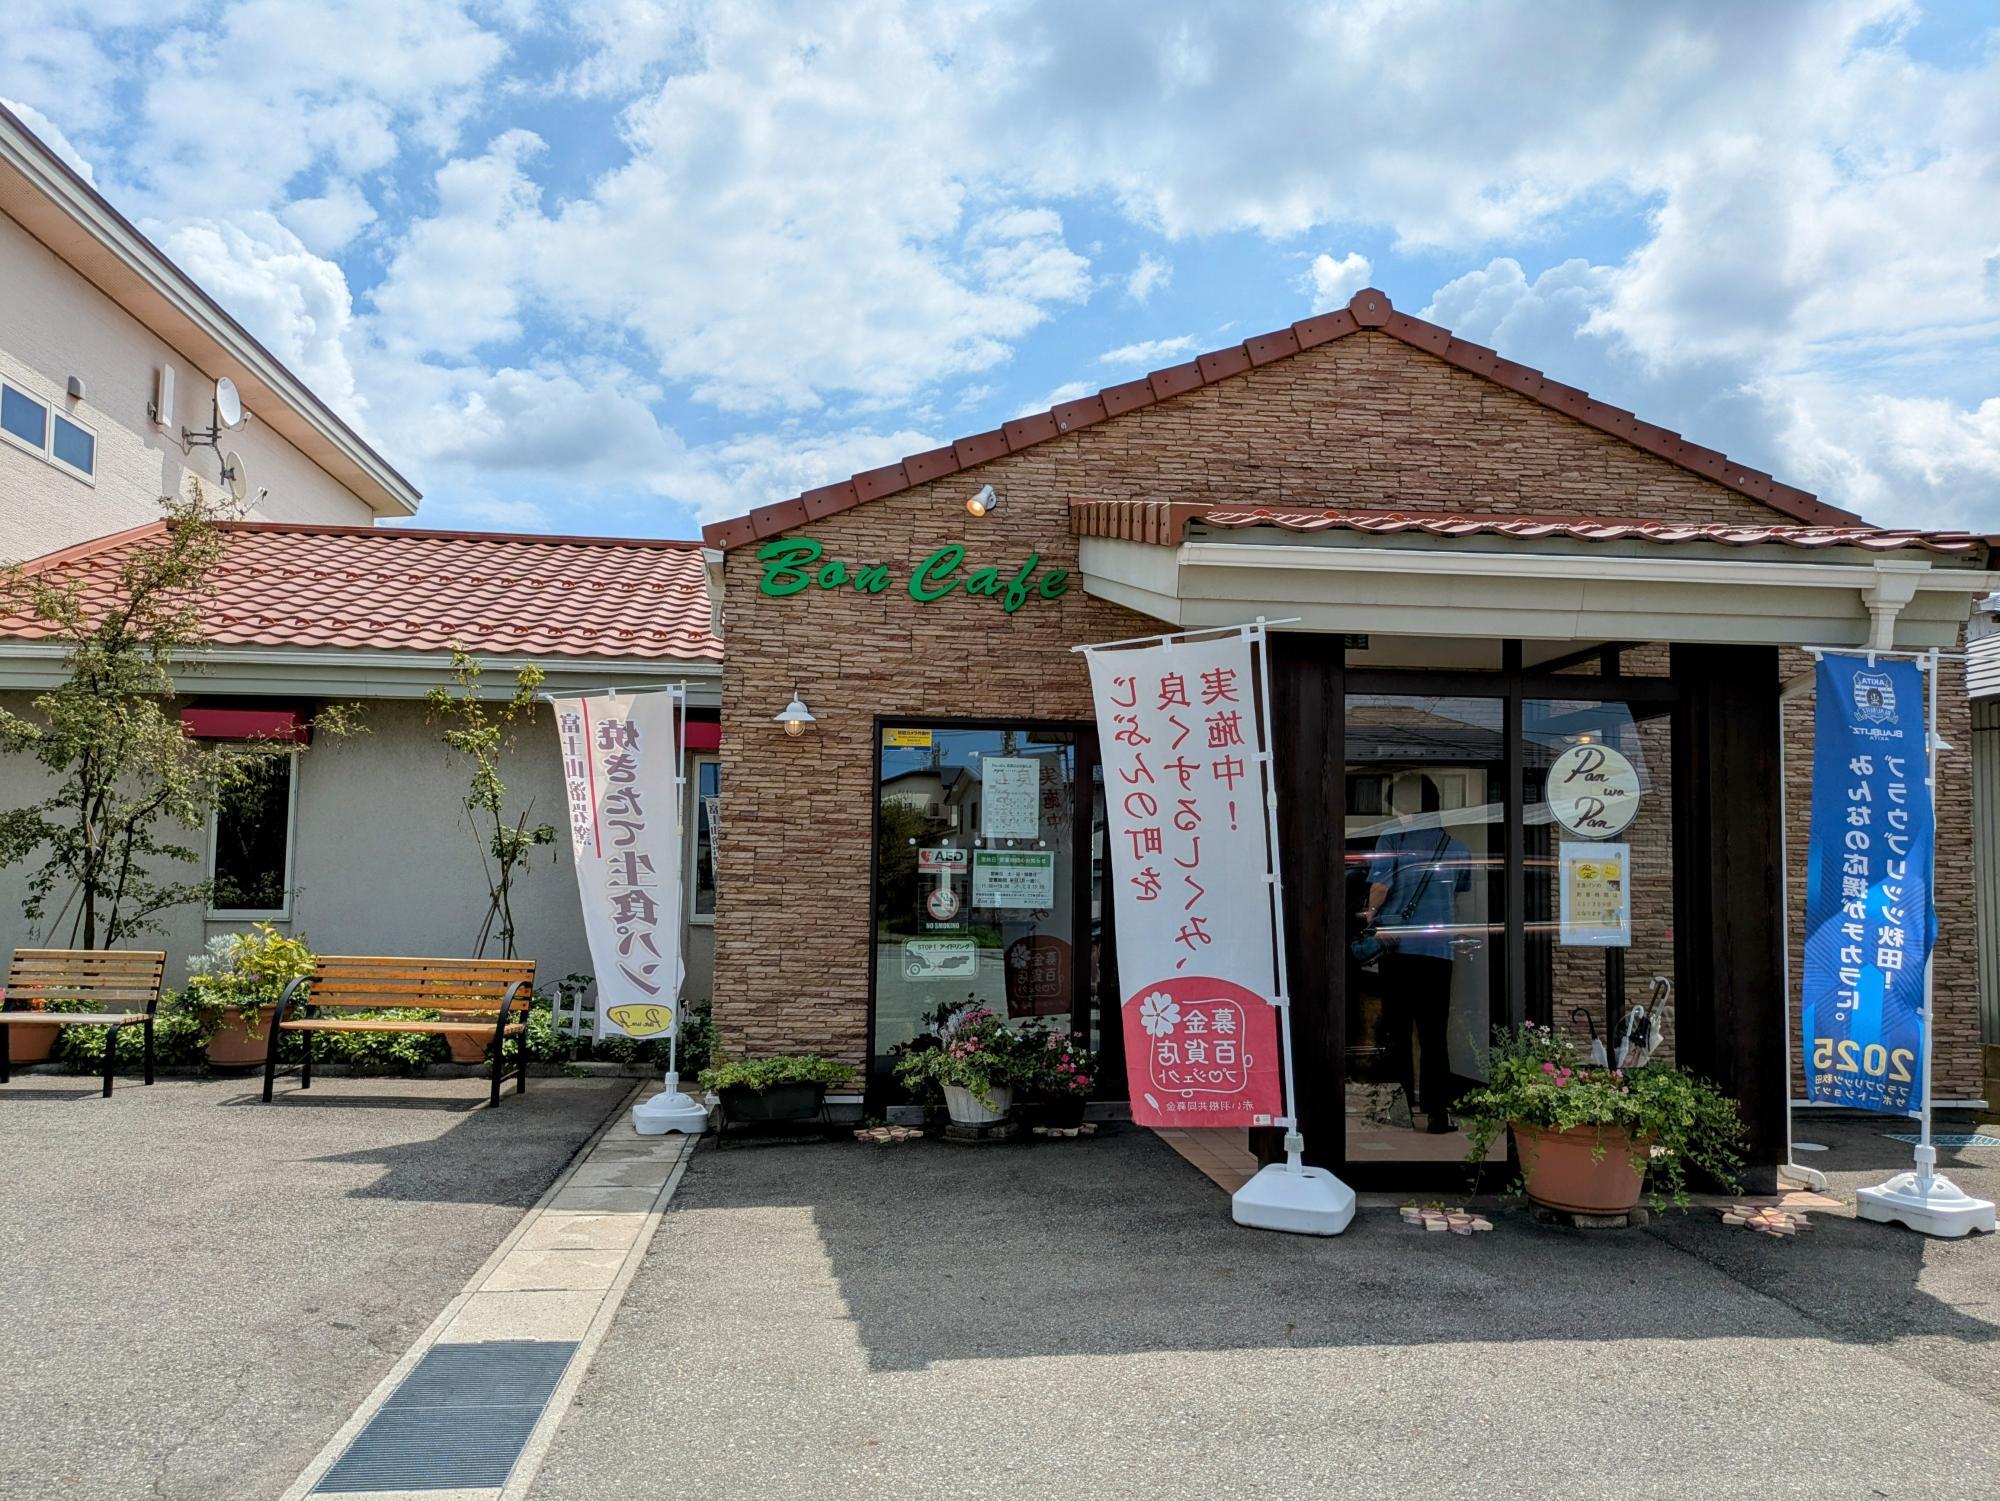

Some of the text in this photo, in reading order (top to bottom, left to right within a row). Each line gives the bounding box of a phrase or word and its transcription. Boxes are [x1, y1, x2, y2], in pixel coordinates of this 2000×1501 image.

[758, 537, 1070, 613] Bon Cafe
[1564, 747, 1609, 783] Pan
[1603, 788, 1627, 797] wa
[1573, 796, 1616, 829] Pan
[935, 851, 964, 862] AED
[926, 922, 960, 930] NO SMOKING
[939, 943, 971, 951] アイドリング
